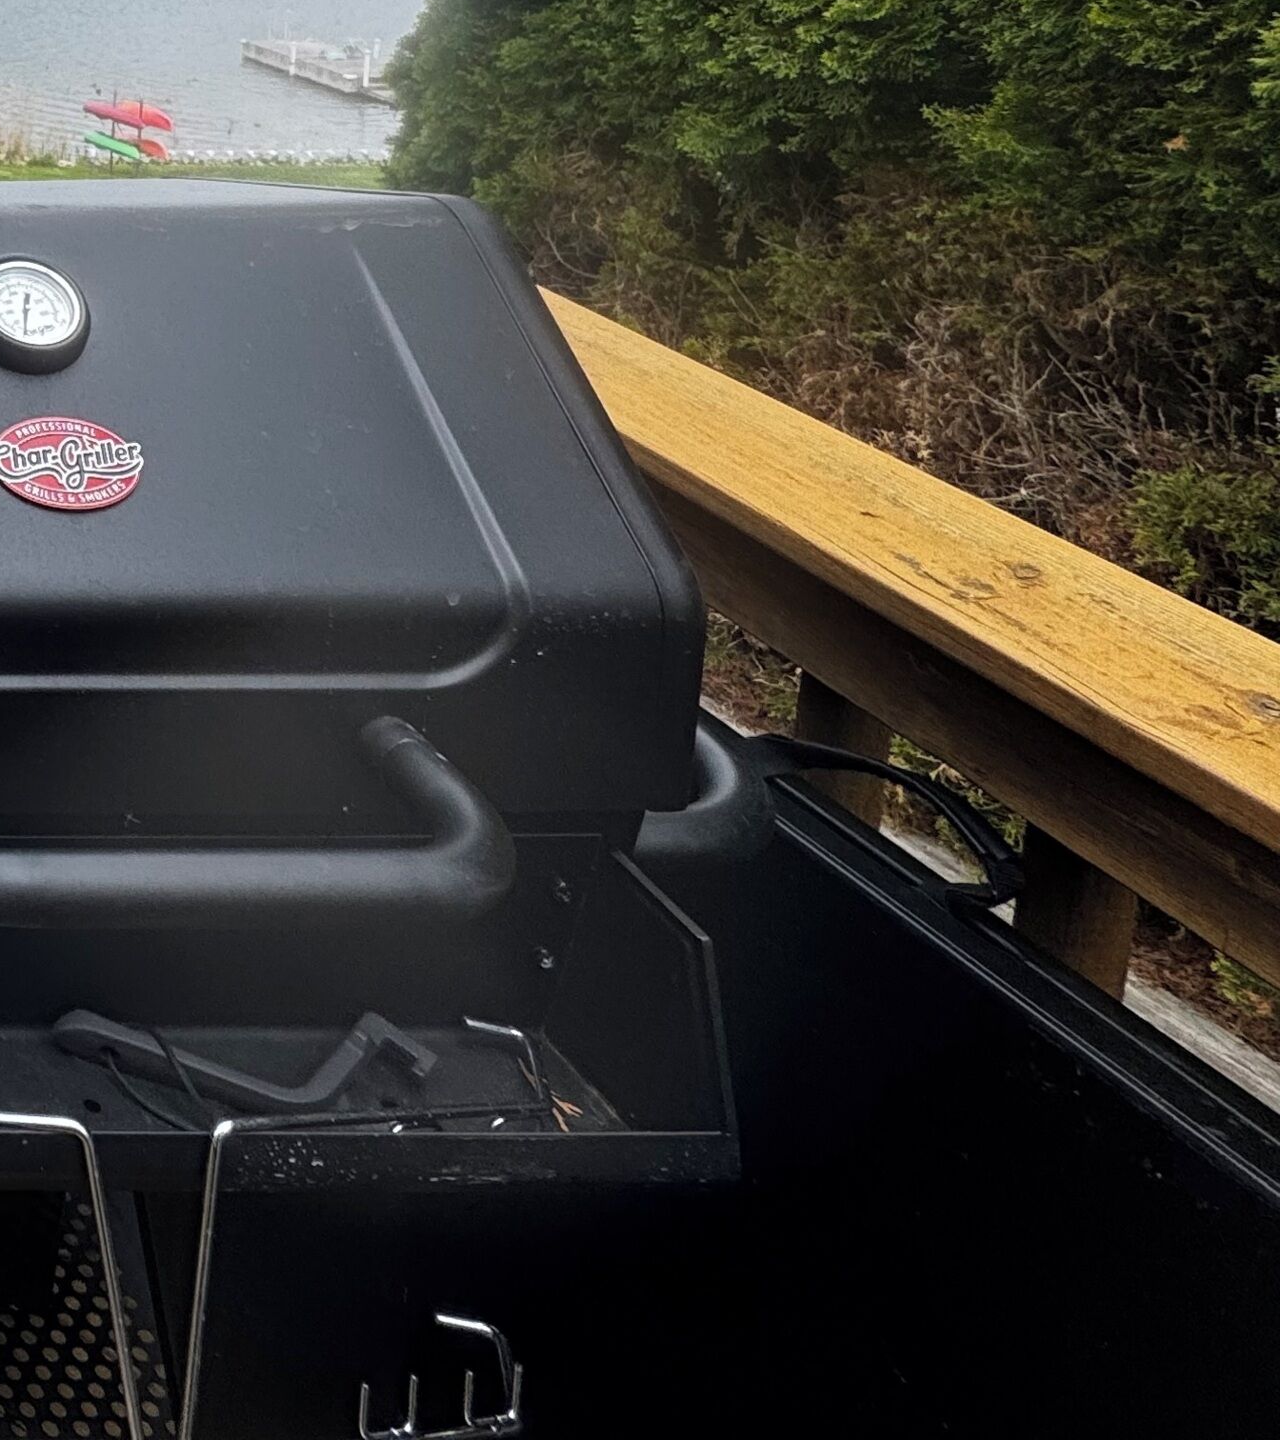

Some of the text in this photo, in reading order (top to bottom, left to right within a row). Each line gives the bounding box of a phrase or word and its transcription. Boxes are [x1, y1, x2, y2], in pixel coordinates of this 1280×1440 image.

[15, 421, 96, 439] PROFESSIONAL
[23, 482, 64, 503] GRILLS
[79, 481, 126, 503] SMOKERS
